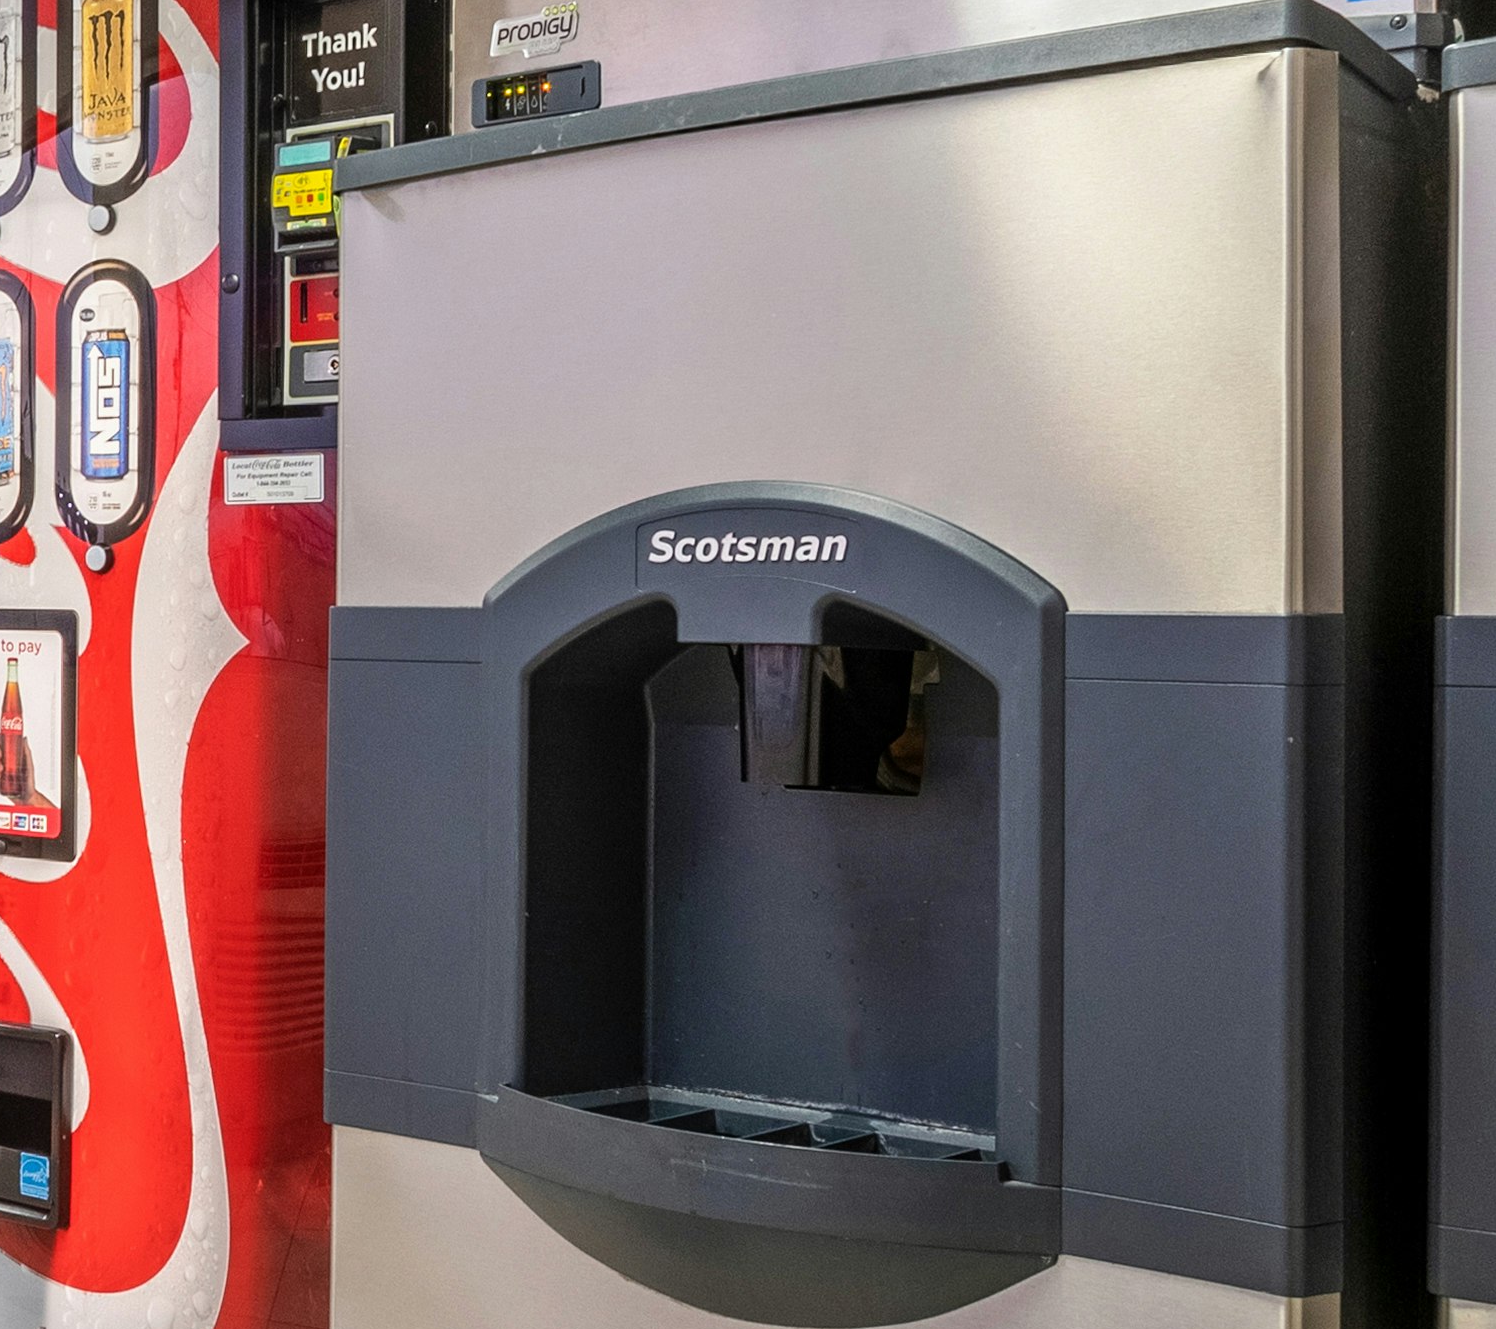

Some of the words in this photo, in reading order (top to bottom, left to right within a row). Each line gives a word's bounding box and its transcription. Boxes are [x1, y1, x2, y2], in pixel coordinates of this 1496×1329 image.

[302, 23, 378, 58] Thank
[311, 62, 366, 93] You!
[88, 87, 127, 110] JAVA
[87, 343, 122, 456] NOS
[232, 462, 251, 470] Local
[283, 460, 314, 468] Bottler
[647, 528, 848, 565] Scotsman
[1, 639, 15, 653] to
[18, 640, 42, 656] pay
